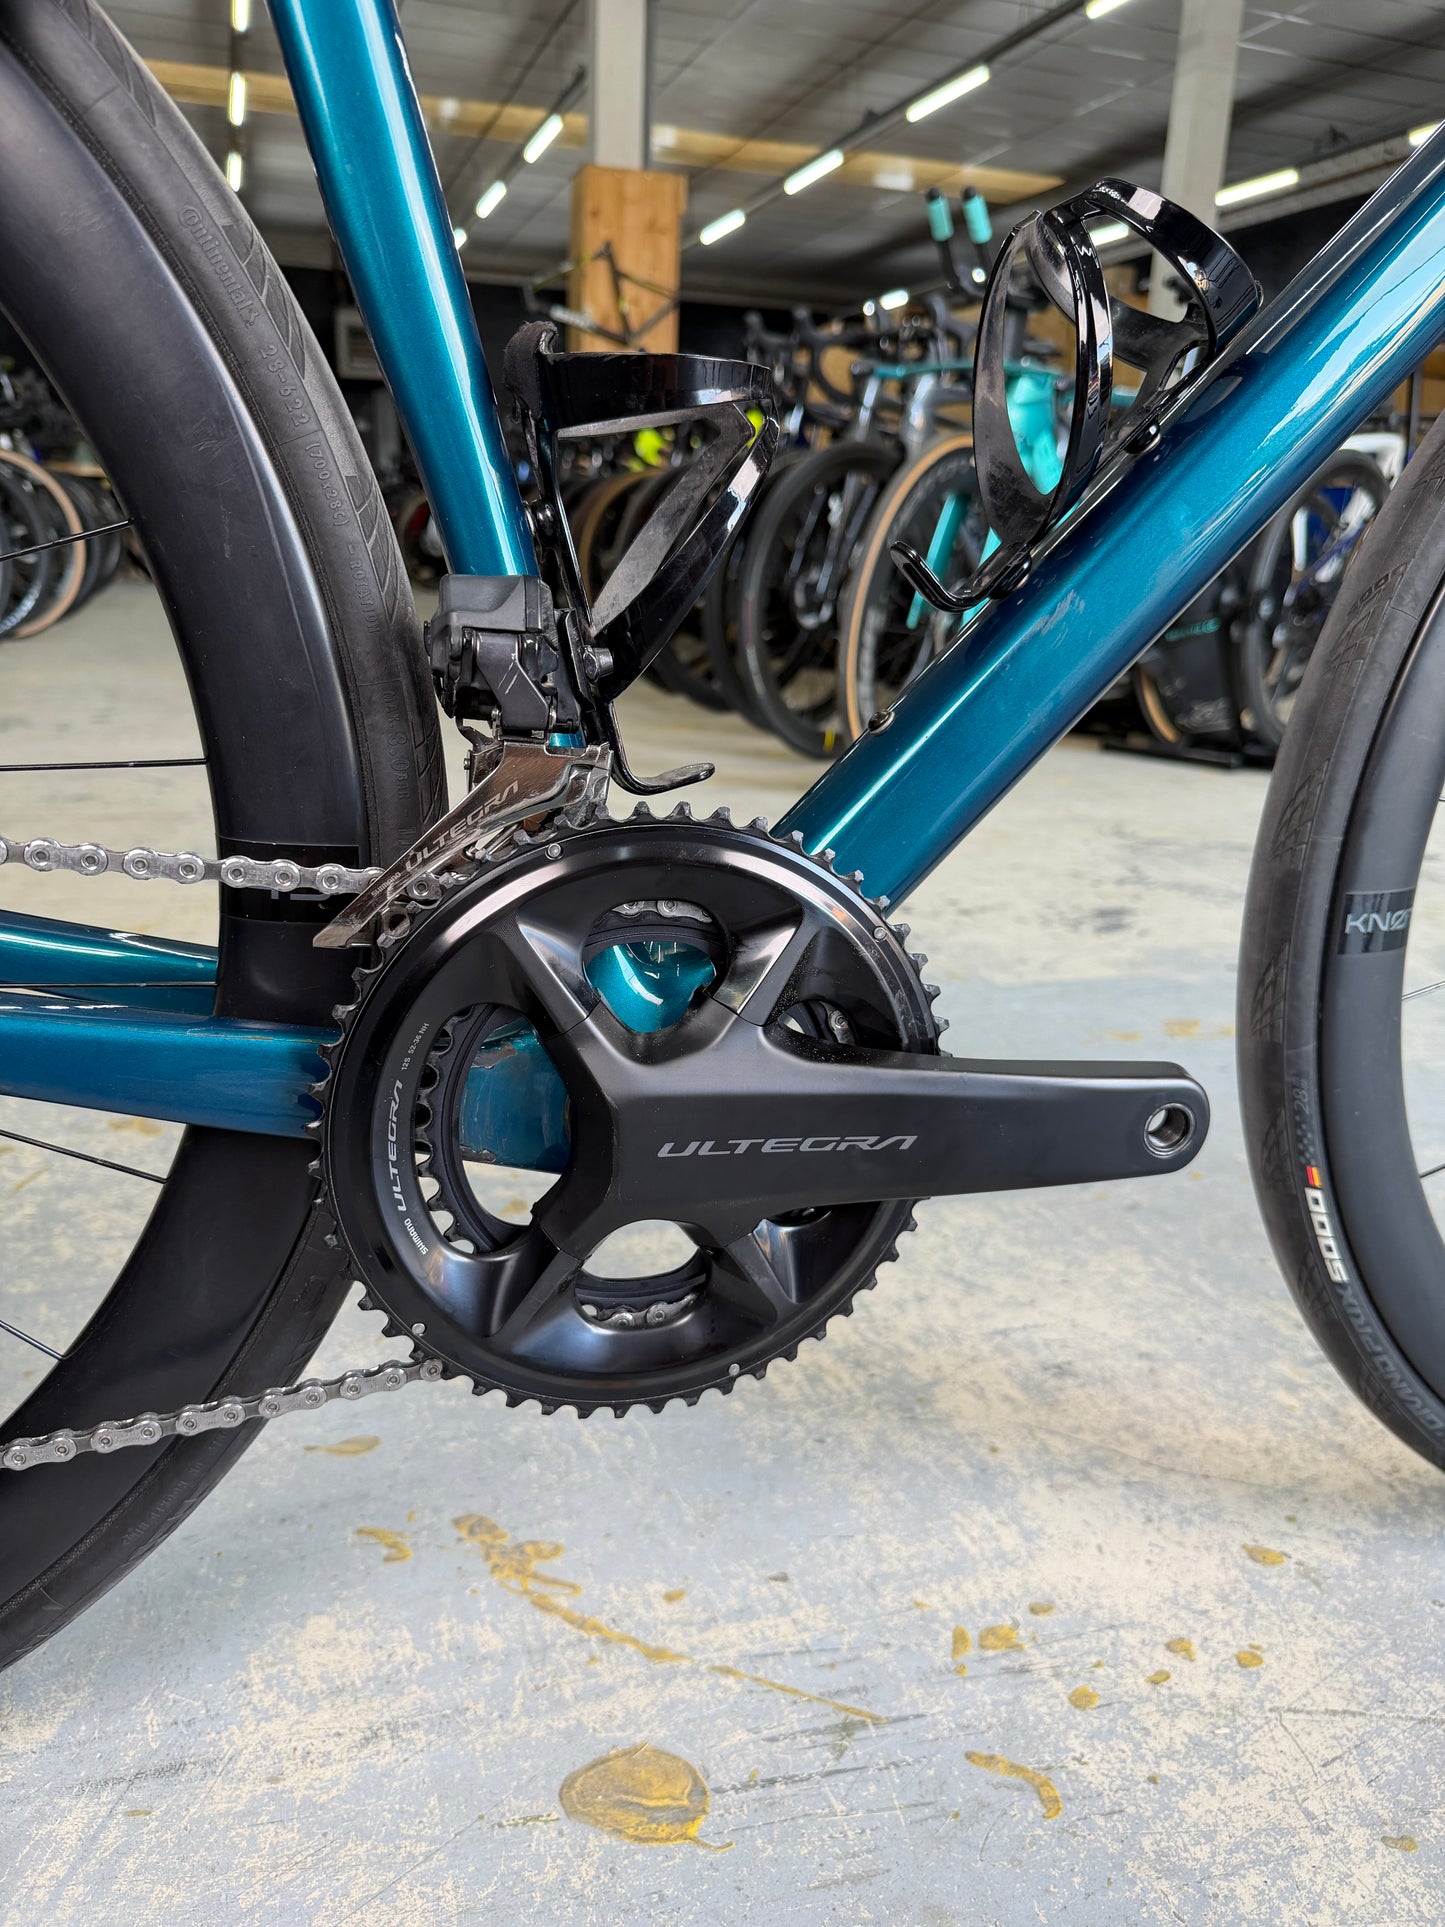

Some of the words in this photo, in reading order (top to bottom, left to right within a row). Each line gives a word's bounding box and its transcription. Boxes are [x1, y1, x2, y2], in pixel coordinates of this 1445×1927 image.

[178, 206, 254, 312] Continental
[259, 344, 311, 428] 28-622
[305, 442, 350, 527] (700x28C)
[349, 560, 380, 634] ROTATION
[371, 871, 401, 898] SHIMANO
[405, 781, 519, 873] ULTEGRA
[408, 1034, 422, 1055] 52-36
[418, 1022, 430, 1035] NH
[401, 1057, 411, 1071] 12S
[388, 1079, 407, 1212] ULTEGRA
[657, 1135, 919, 1158] ULTEGRA
[404, 1217, 429, 1256] SHIMANO
[1304, 1187, 1349, 1284] 5000
